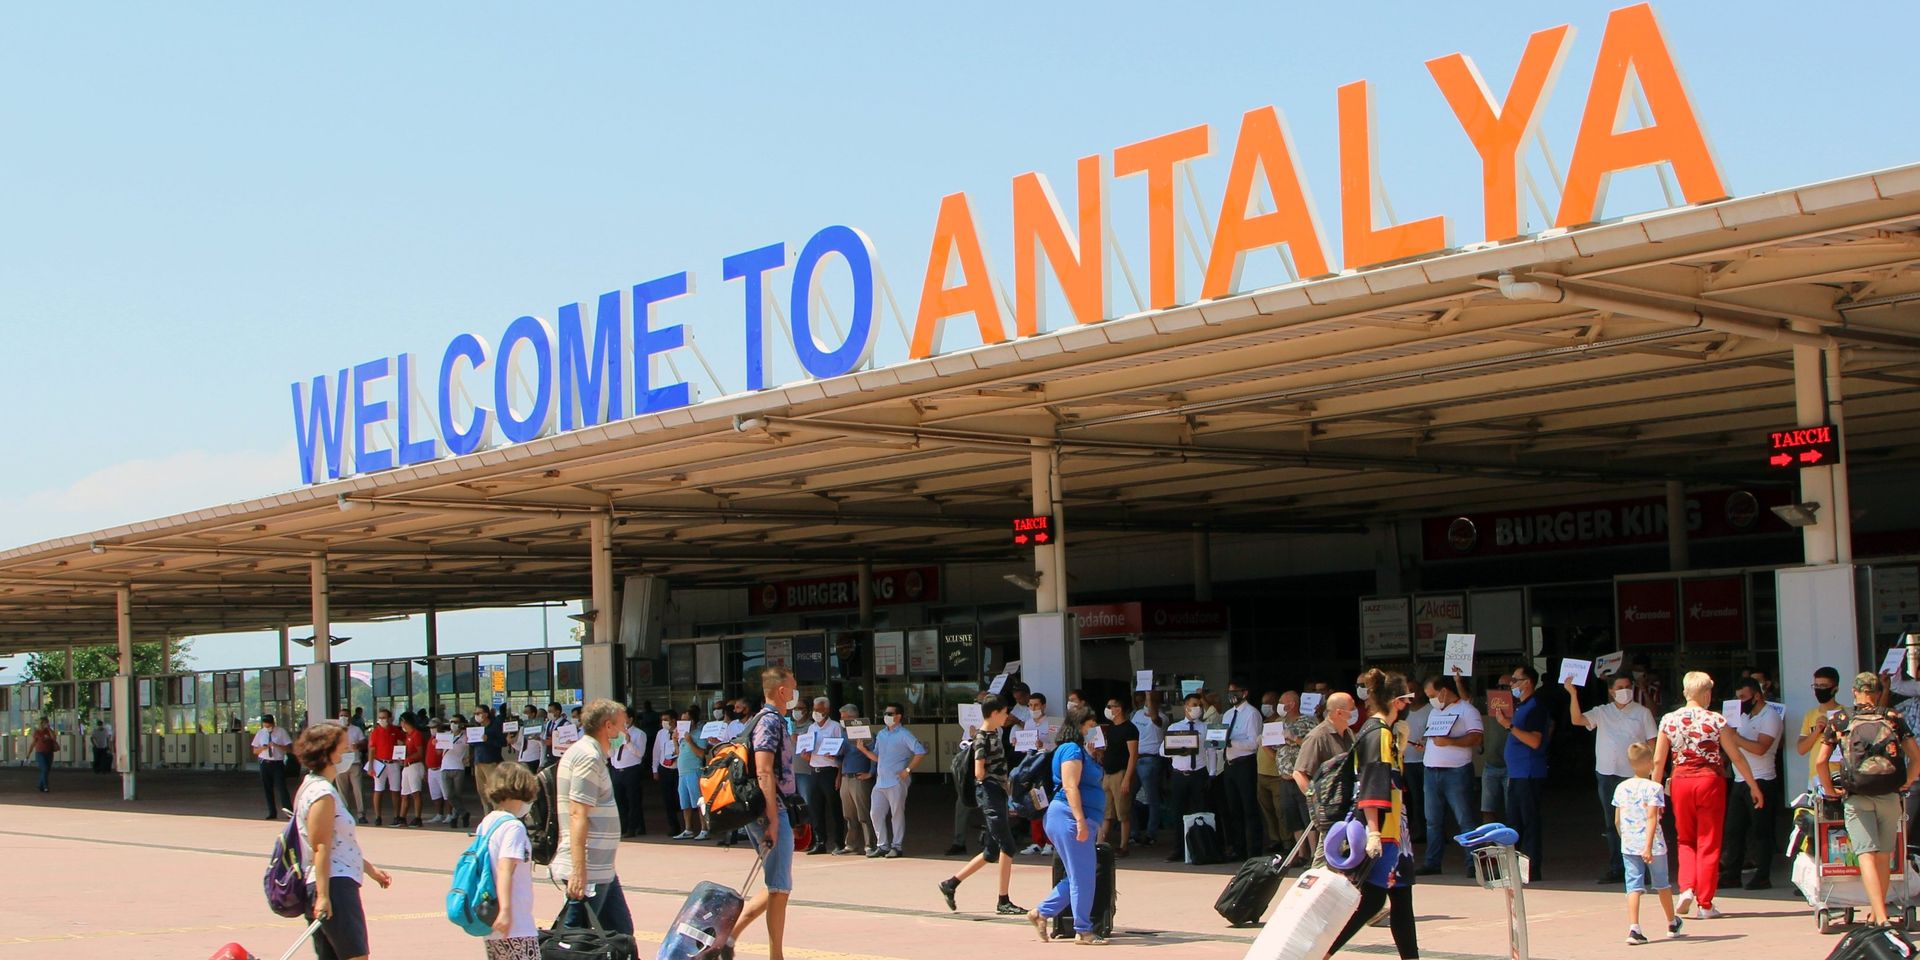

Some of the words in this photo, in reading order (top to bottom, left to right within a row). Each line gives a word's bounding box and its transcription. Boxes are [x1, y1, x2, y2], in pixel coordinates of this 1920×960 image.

[291, 270, 693, 485] WELCOME
[723, 224, 877, 392] TO
[909, 2, 1728, 359] ANTALYA
[1772, 427, 1831, 449] ТАКСИ
[1014, 516, 1048, 531] ТАКСИ
[1496, 509, 1615, 546] BURGER
[787, 582, 849, 607] BURGER
[852, 576, 895, 602] KNG
[797, 652, 822, 661] FISCHER
